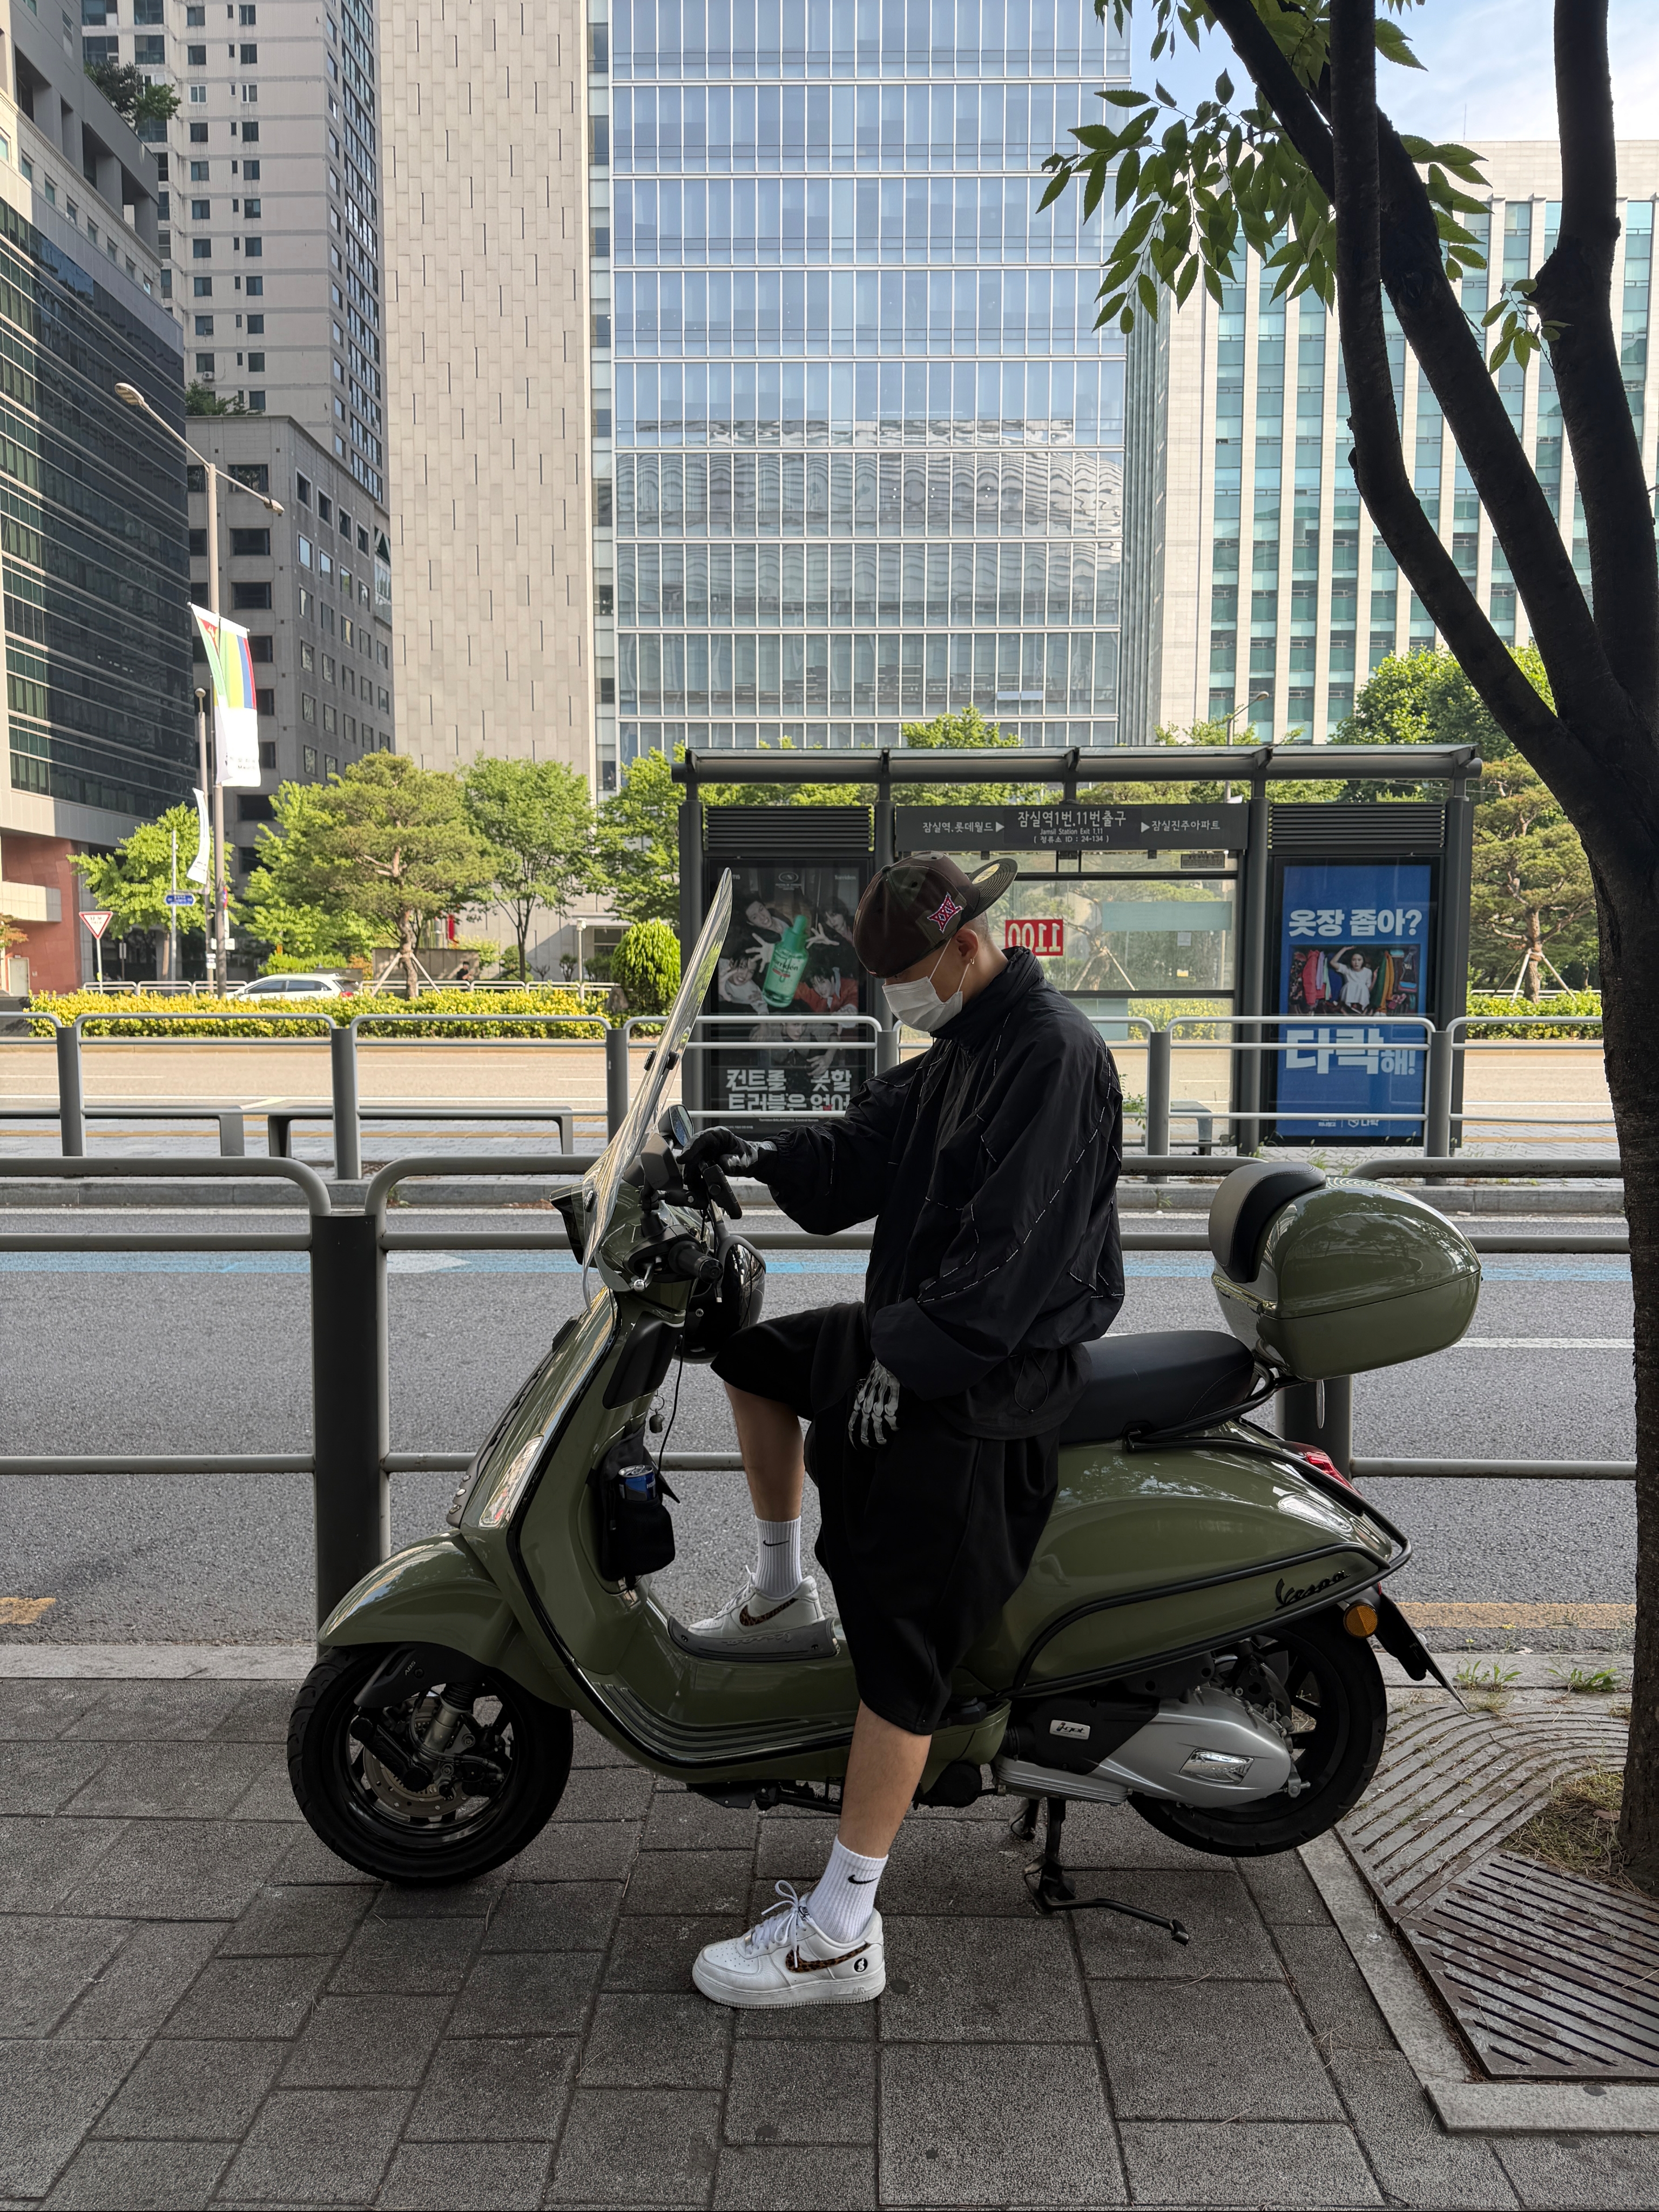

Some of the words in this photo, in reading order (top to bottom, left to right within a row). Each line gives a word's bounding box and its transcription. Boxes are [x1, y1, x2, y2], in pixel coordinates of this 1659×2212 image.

[1017, 810, 1126, 827] 잠실역1번.11번출구
[1151, 820, 1220, 832] 잠실진주아파트
[922, 821, 994, 834] 잠실역.롯데월드
[1040, 835, 1062, 844] 정류소
[1289, 909, 1345, 937] 옷장
[1350, 909, 1422, 936] 좁아?
[726, 1069, 787, 1091] 컨트롤
[811, 1069, 852, 1092] 못할
[1275, 1570, 1351, 1611] Vespa
[405, 1660, 416, 1676] ABS
